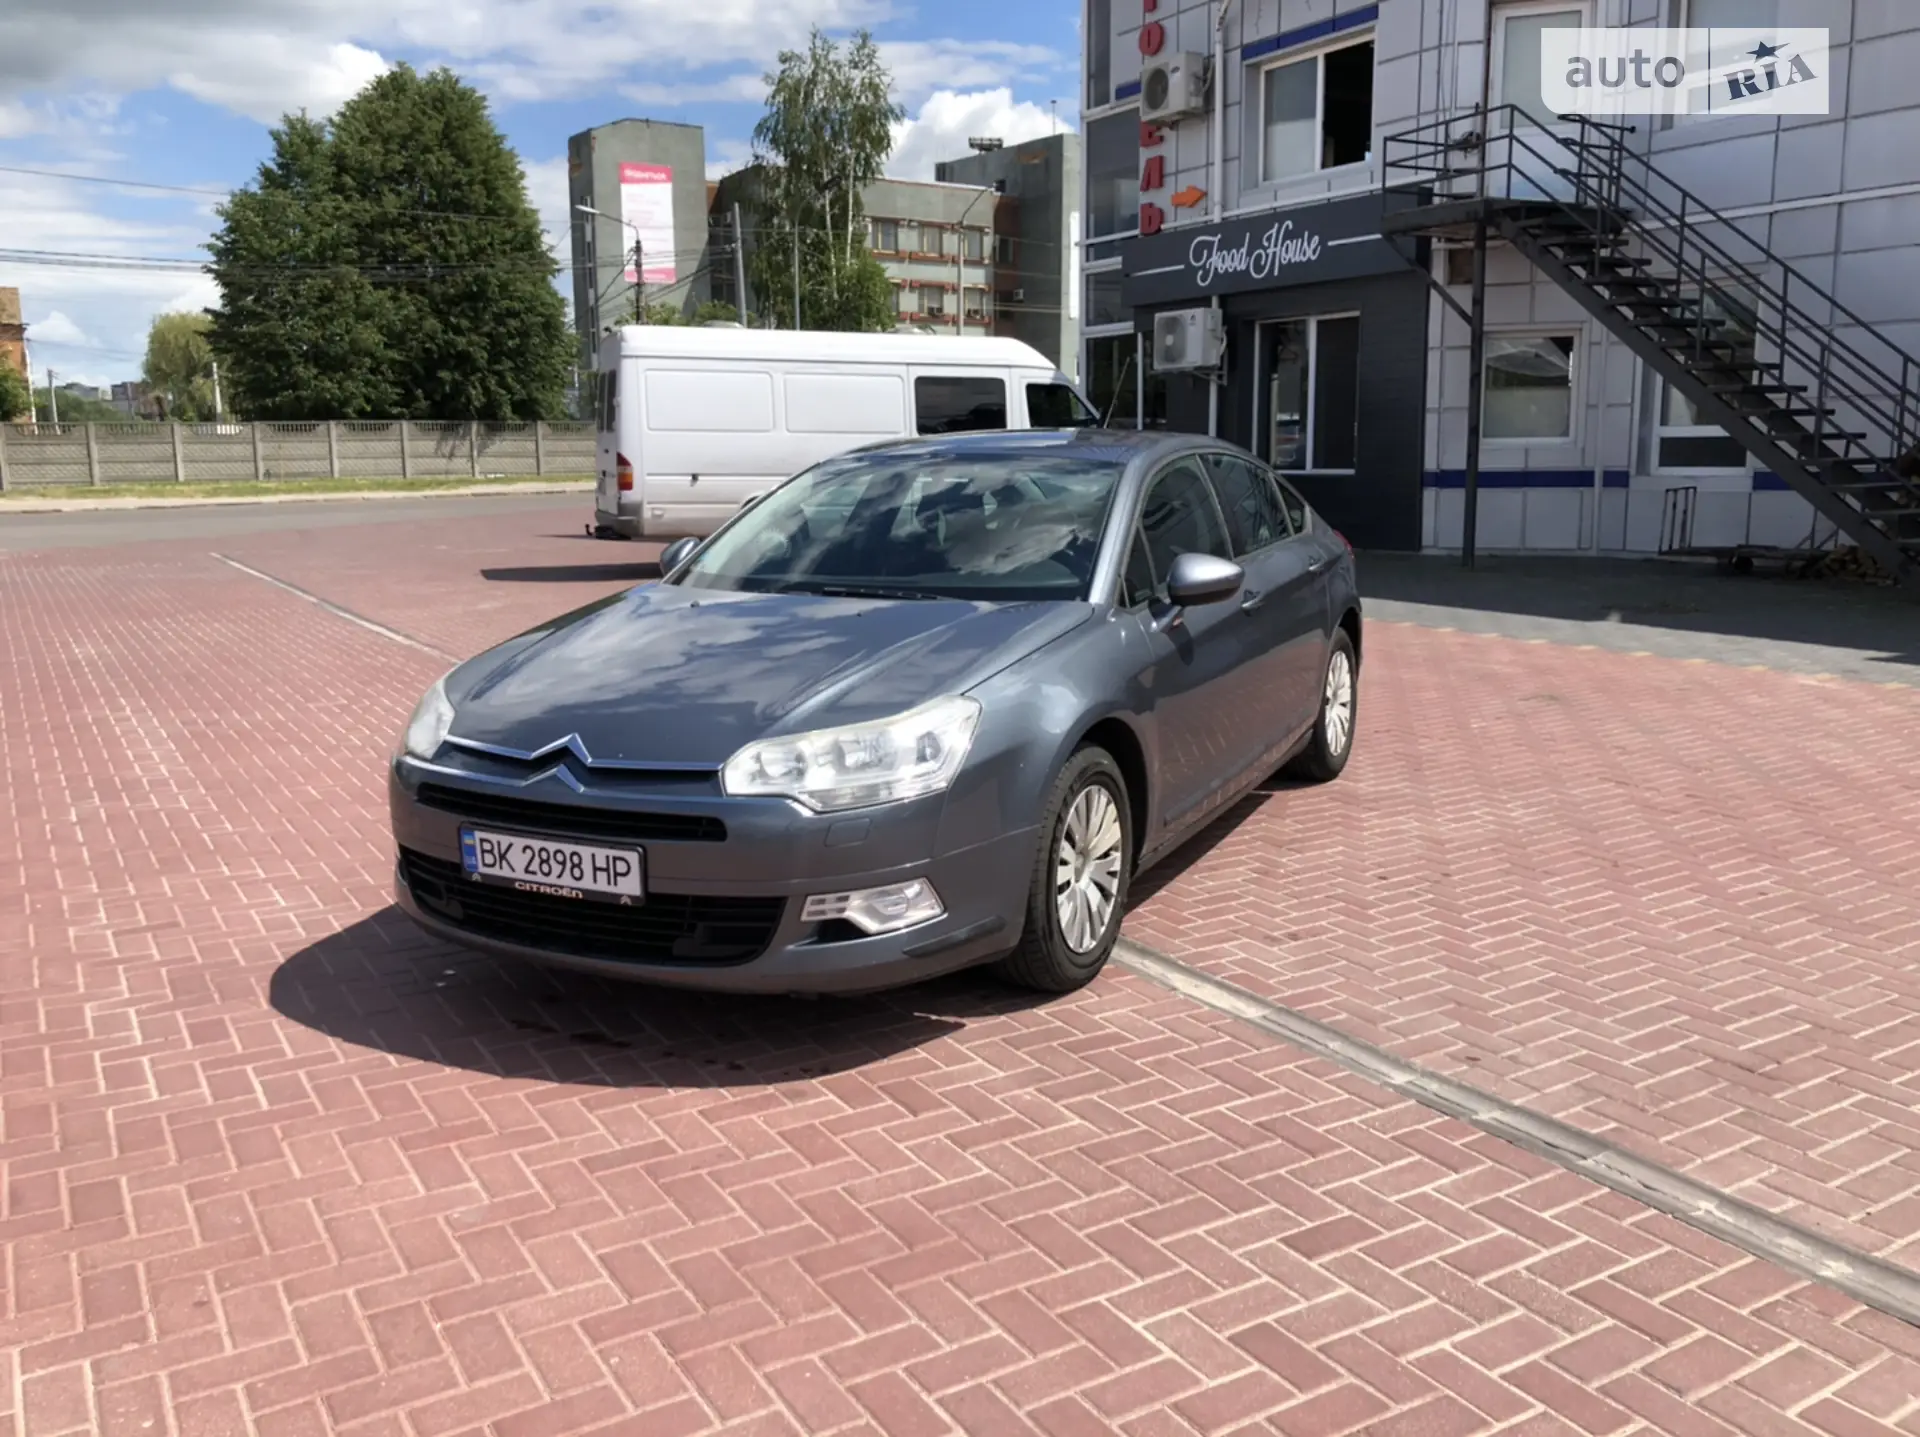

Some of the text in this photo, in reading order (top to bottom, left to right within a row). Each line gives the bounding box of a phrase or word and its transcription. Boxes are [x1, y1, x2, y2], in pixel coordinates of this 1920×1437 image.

[1189, 220, 1321, 287] Food House
[479, 838, 632, 887] BK 2898 HP
